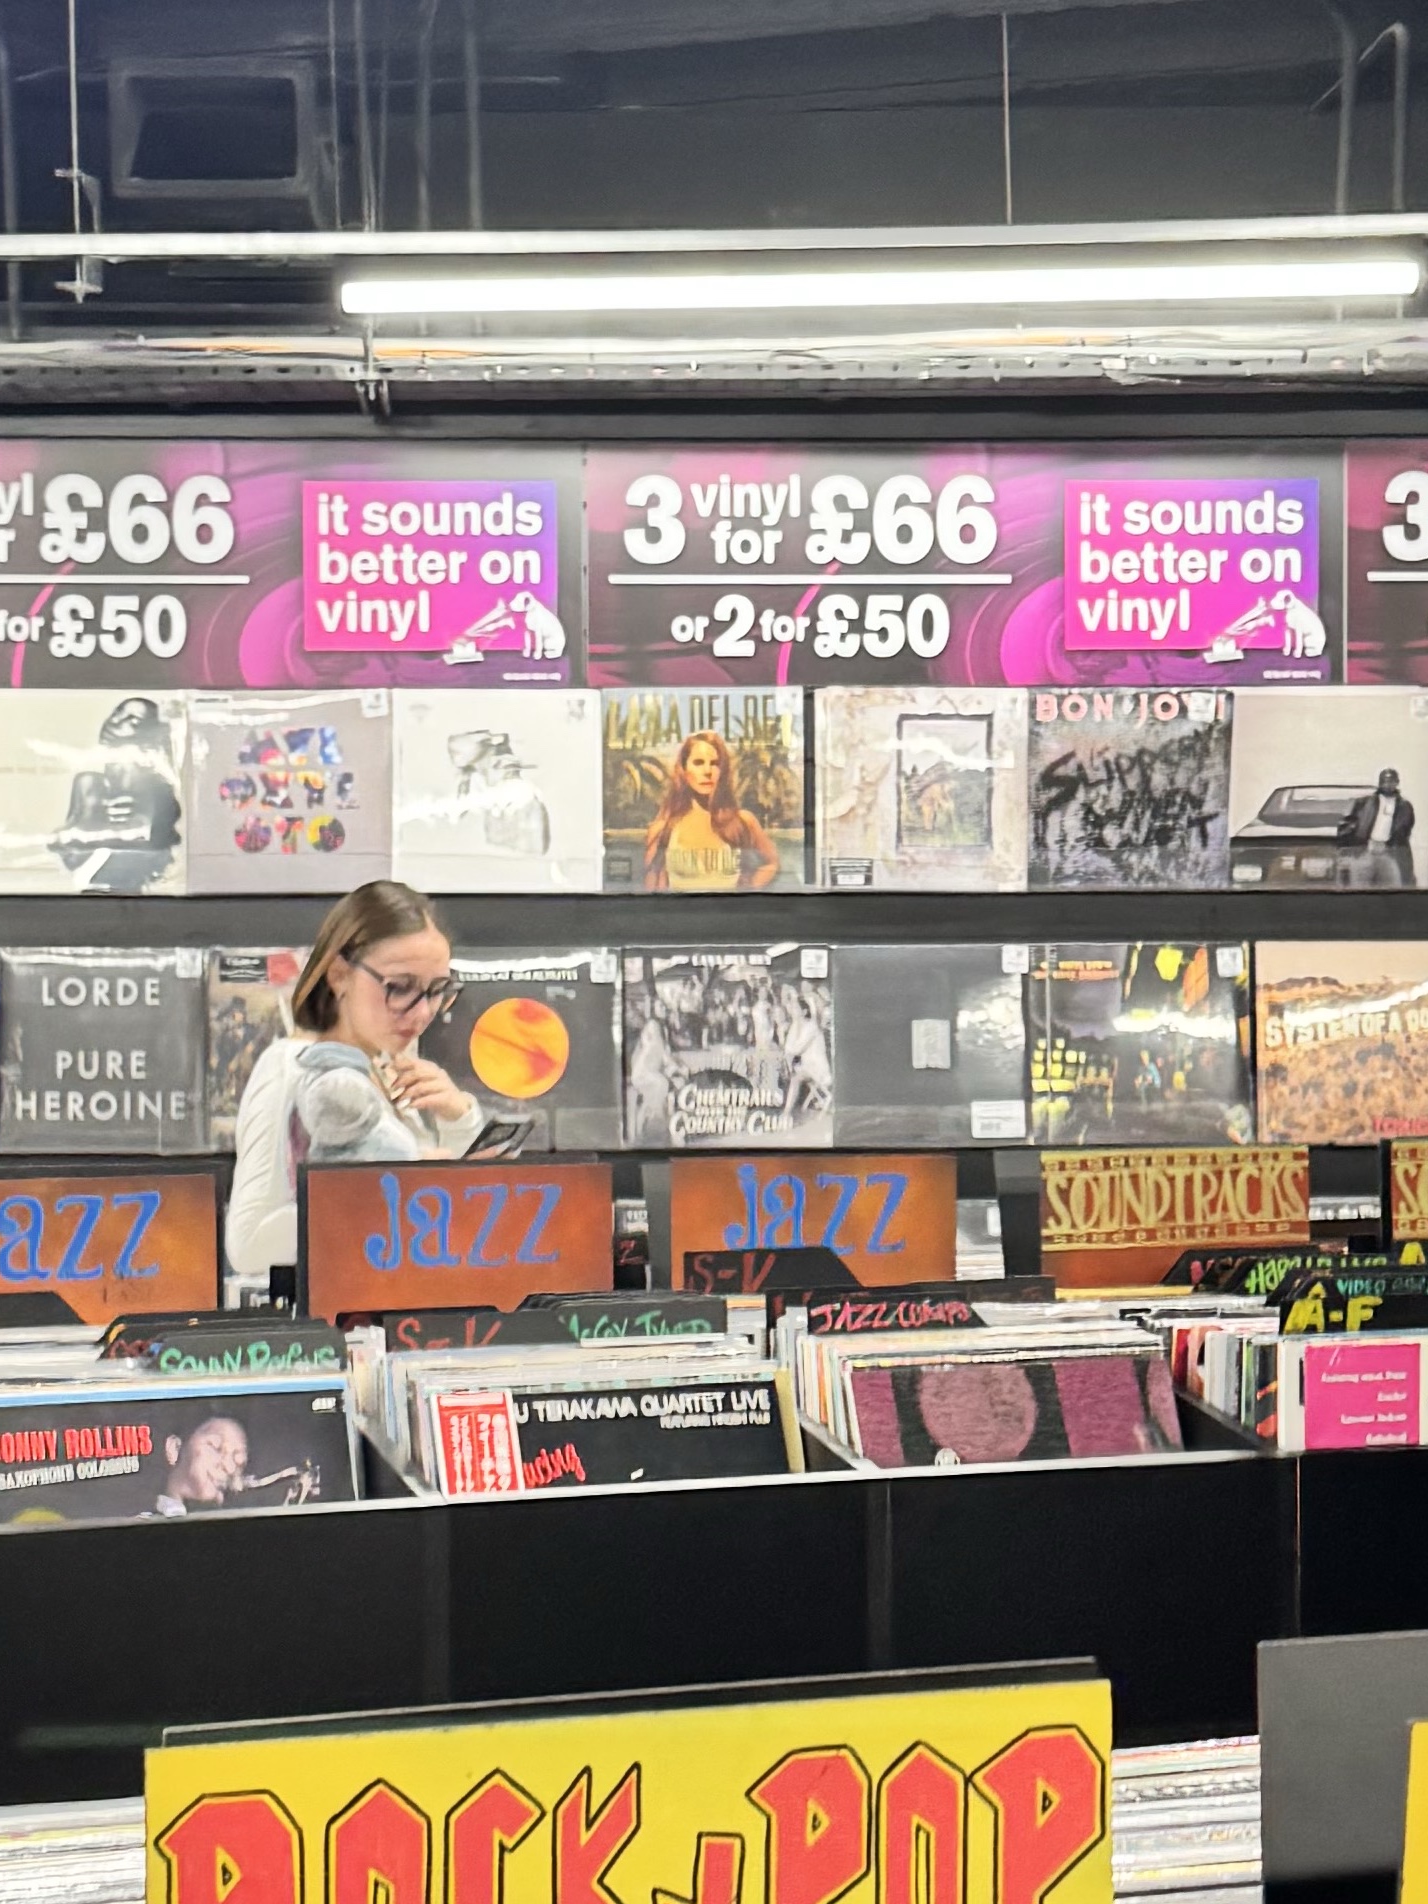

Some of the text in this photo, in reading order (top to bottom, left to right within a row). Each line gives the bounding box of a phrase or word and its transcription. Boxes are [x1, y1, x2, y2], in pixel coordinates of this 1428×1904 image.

[39, 474, 236, 564] £66
[318, 491, 544, 537] it sounds
[623, 474, 997, 566] 3 vinyl for £66
[1078, 491, 1304, 537] it sounds
[318, 541, 543, 586] better on
[1078, 540, 1303, 585] better on
[49, 594, 189, 659] £50
[317, 591, 433, 643] vinyl
[670, 594, 951, 659] or 2 for £50
[1076, 588, 1191, 642] vinyl
[1036, 693, 1113, 722] BON
[41, 977, 161, 1007] LORDE
[56, 1051, 146, 1079] PURE
[16, 1090, 186, 1121] HEROINE
[1045, 1160, 1309, 1232] SOUNDTRACKS
[1284, 1282, 1383, 1334] A-F
[730, 1389, 771, 1411] LIVE
[64, 1425, 153, 1460] ROLLINS
